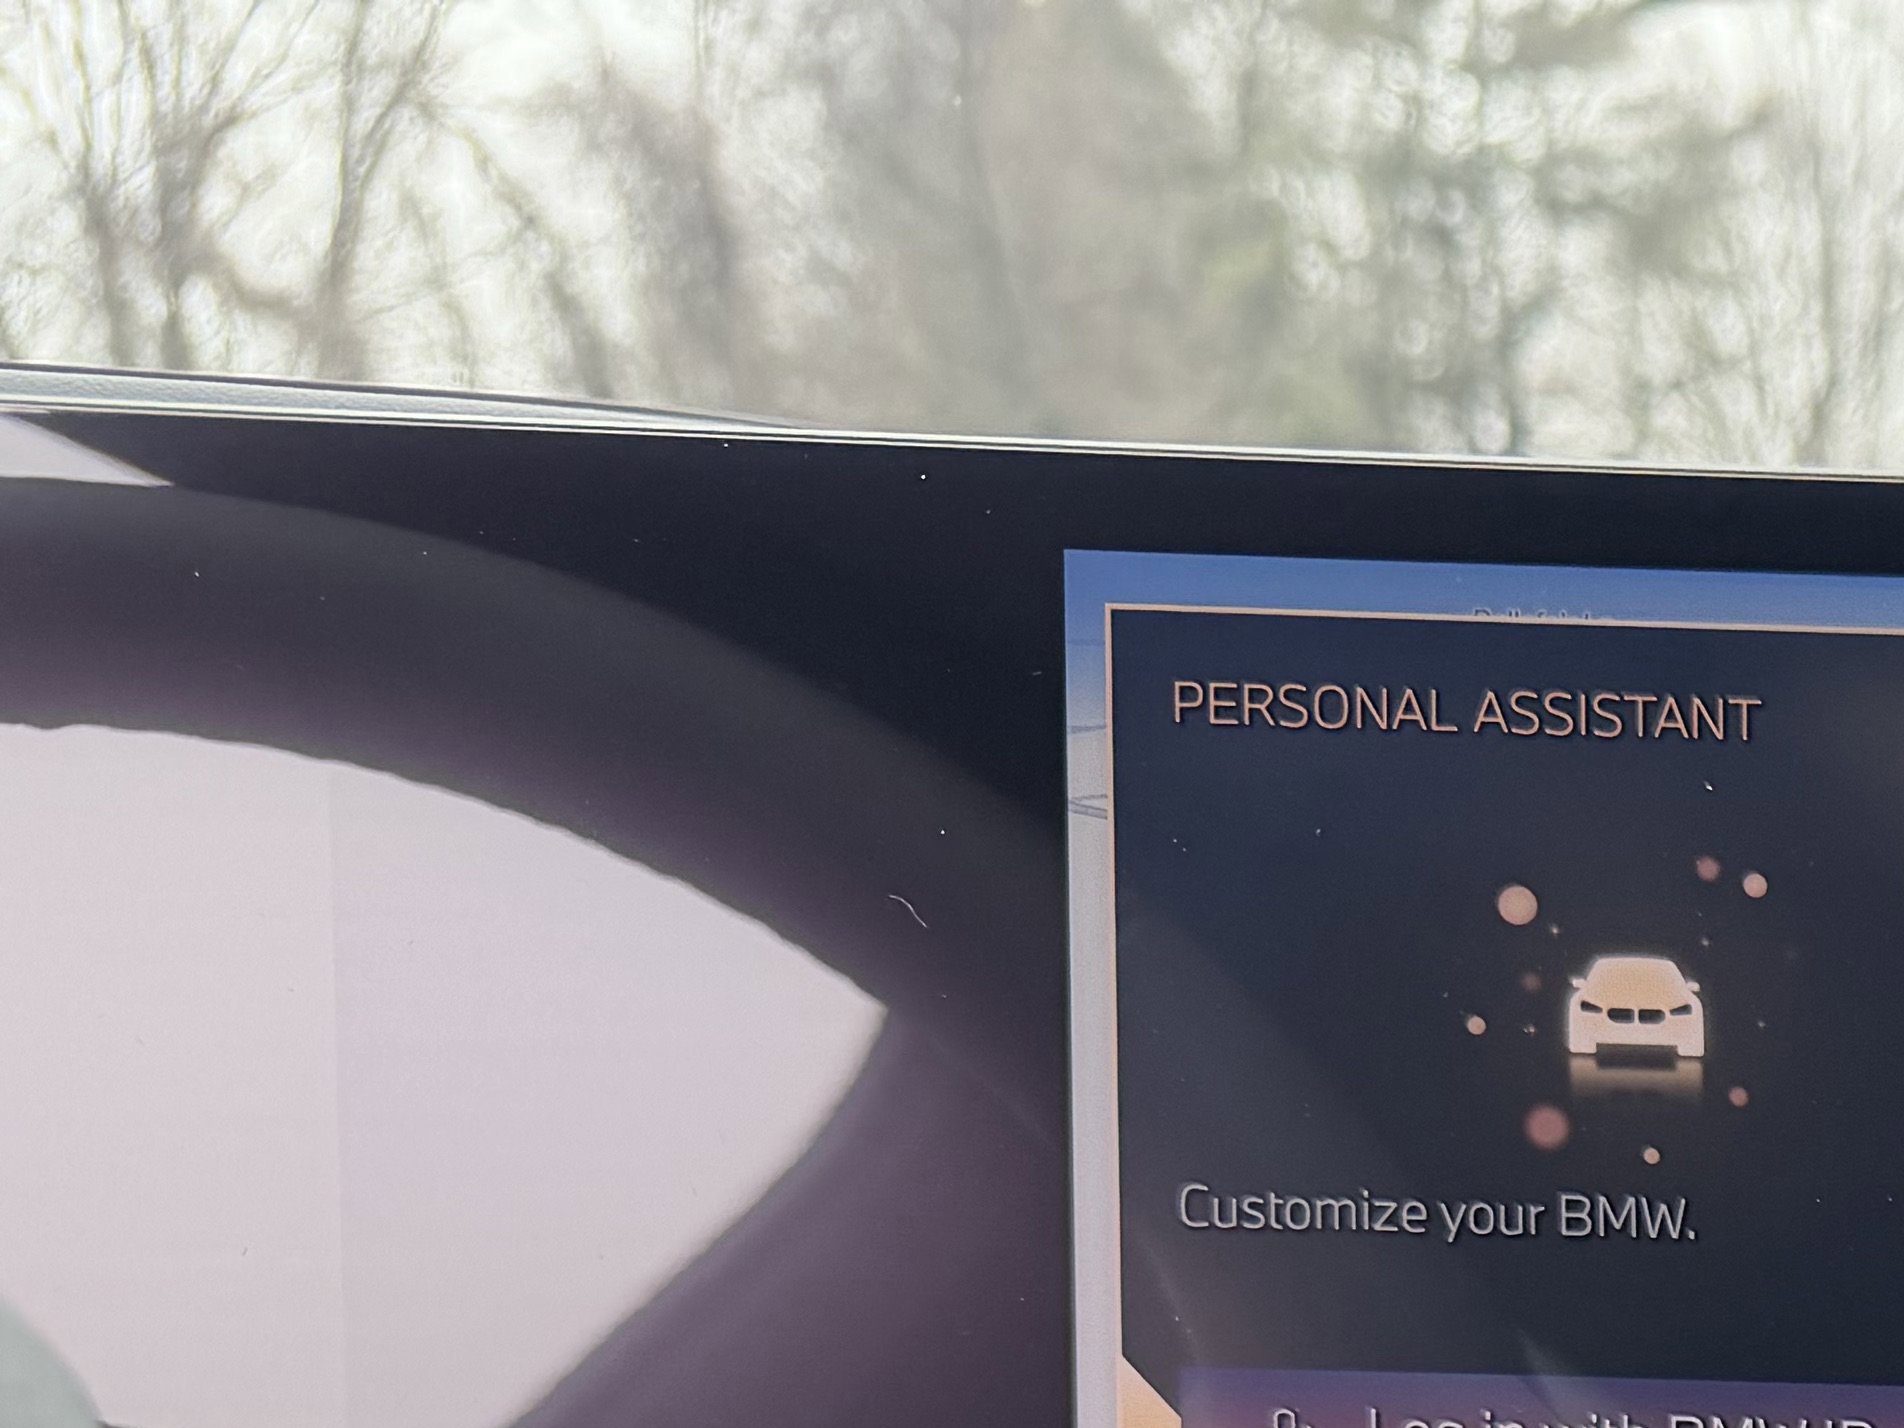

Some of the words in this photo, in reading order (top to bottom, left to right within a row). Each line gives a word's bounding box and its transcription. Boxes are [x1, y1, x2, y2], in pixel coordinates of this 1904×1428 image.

[1174, 680, 1459, 732] PERSONAL
[1473, 690, 1762, 741] ASSISTANT
[1179, 1182, 1427, 1233] Customize
[1439, 1201, 1545, 1243] your
[1560, 1193, 1695, 1240] BMW.
